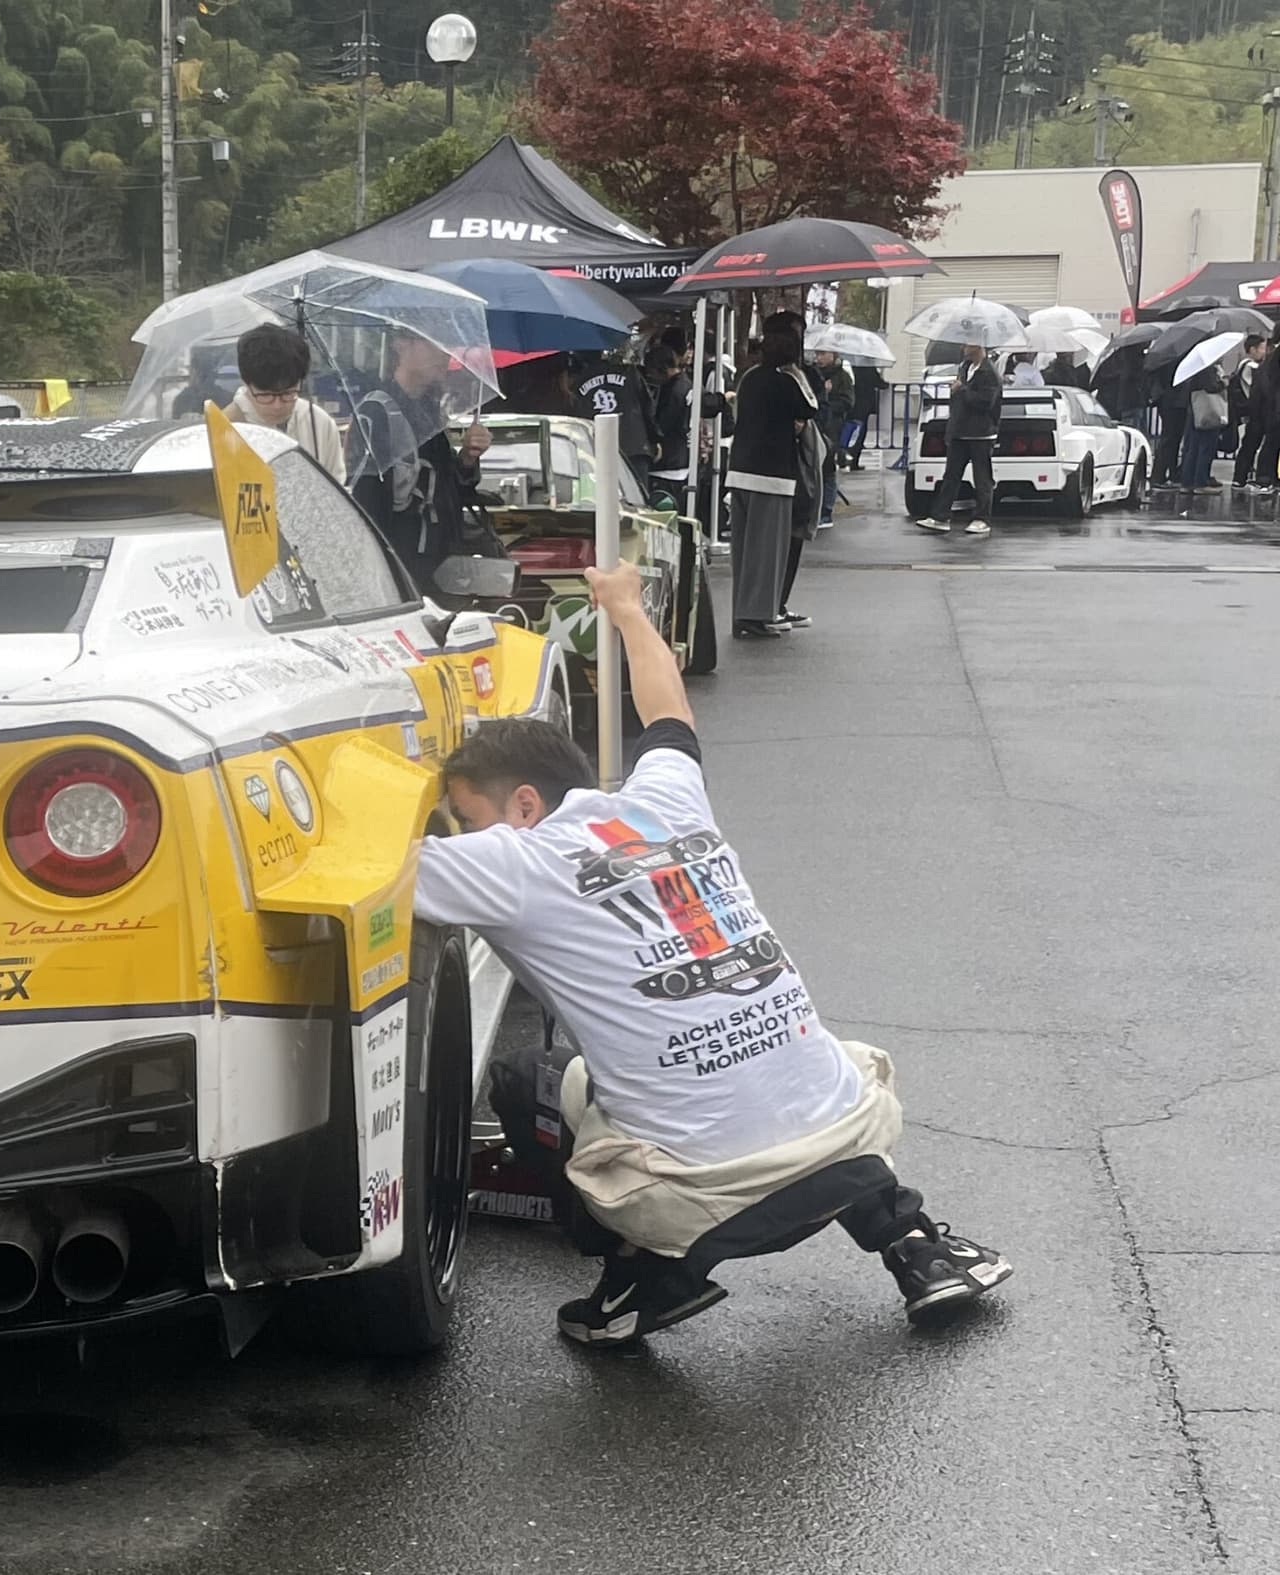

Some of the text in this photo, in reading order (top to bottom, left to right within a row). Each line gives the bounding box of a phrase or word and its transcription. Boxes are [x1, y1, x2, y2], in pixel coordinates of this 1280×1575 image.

[429, 218, 560, 244] LBWK
[258, 824, 298, 867] ecrin
[1, 916, 159, 936] Valenti
[634, 906, 761, 967] LIBERTY WAL
[658, 1002, 813, 1068] LET'S ENJOY TH
[667, 1018, 727, 1050] AICHI
[729, 1000, 768, 1027] SKY
[696, 1029, 791, 1077] MOMENT!
